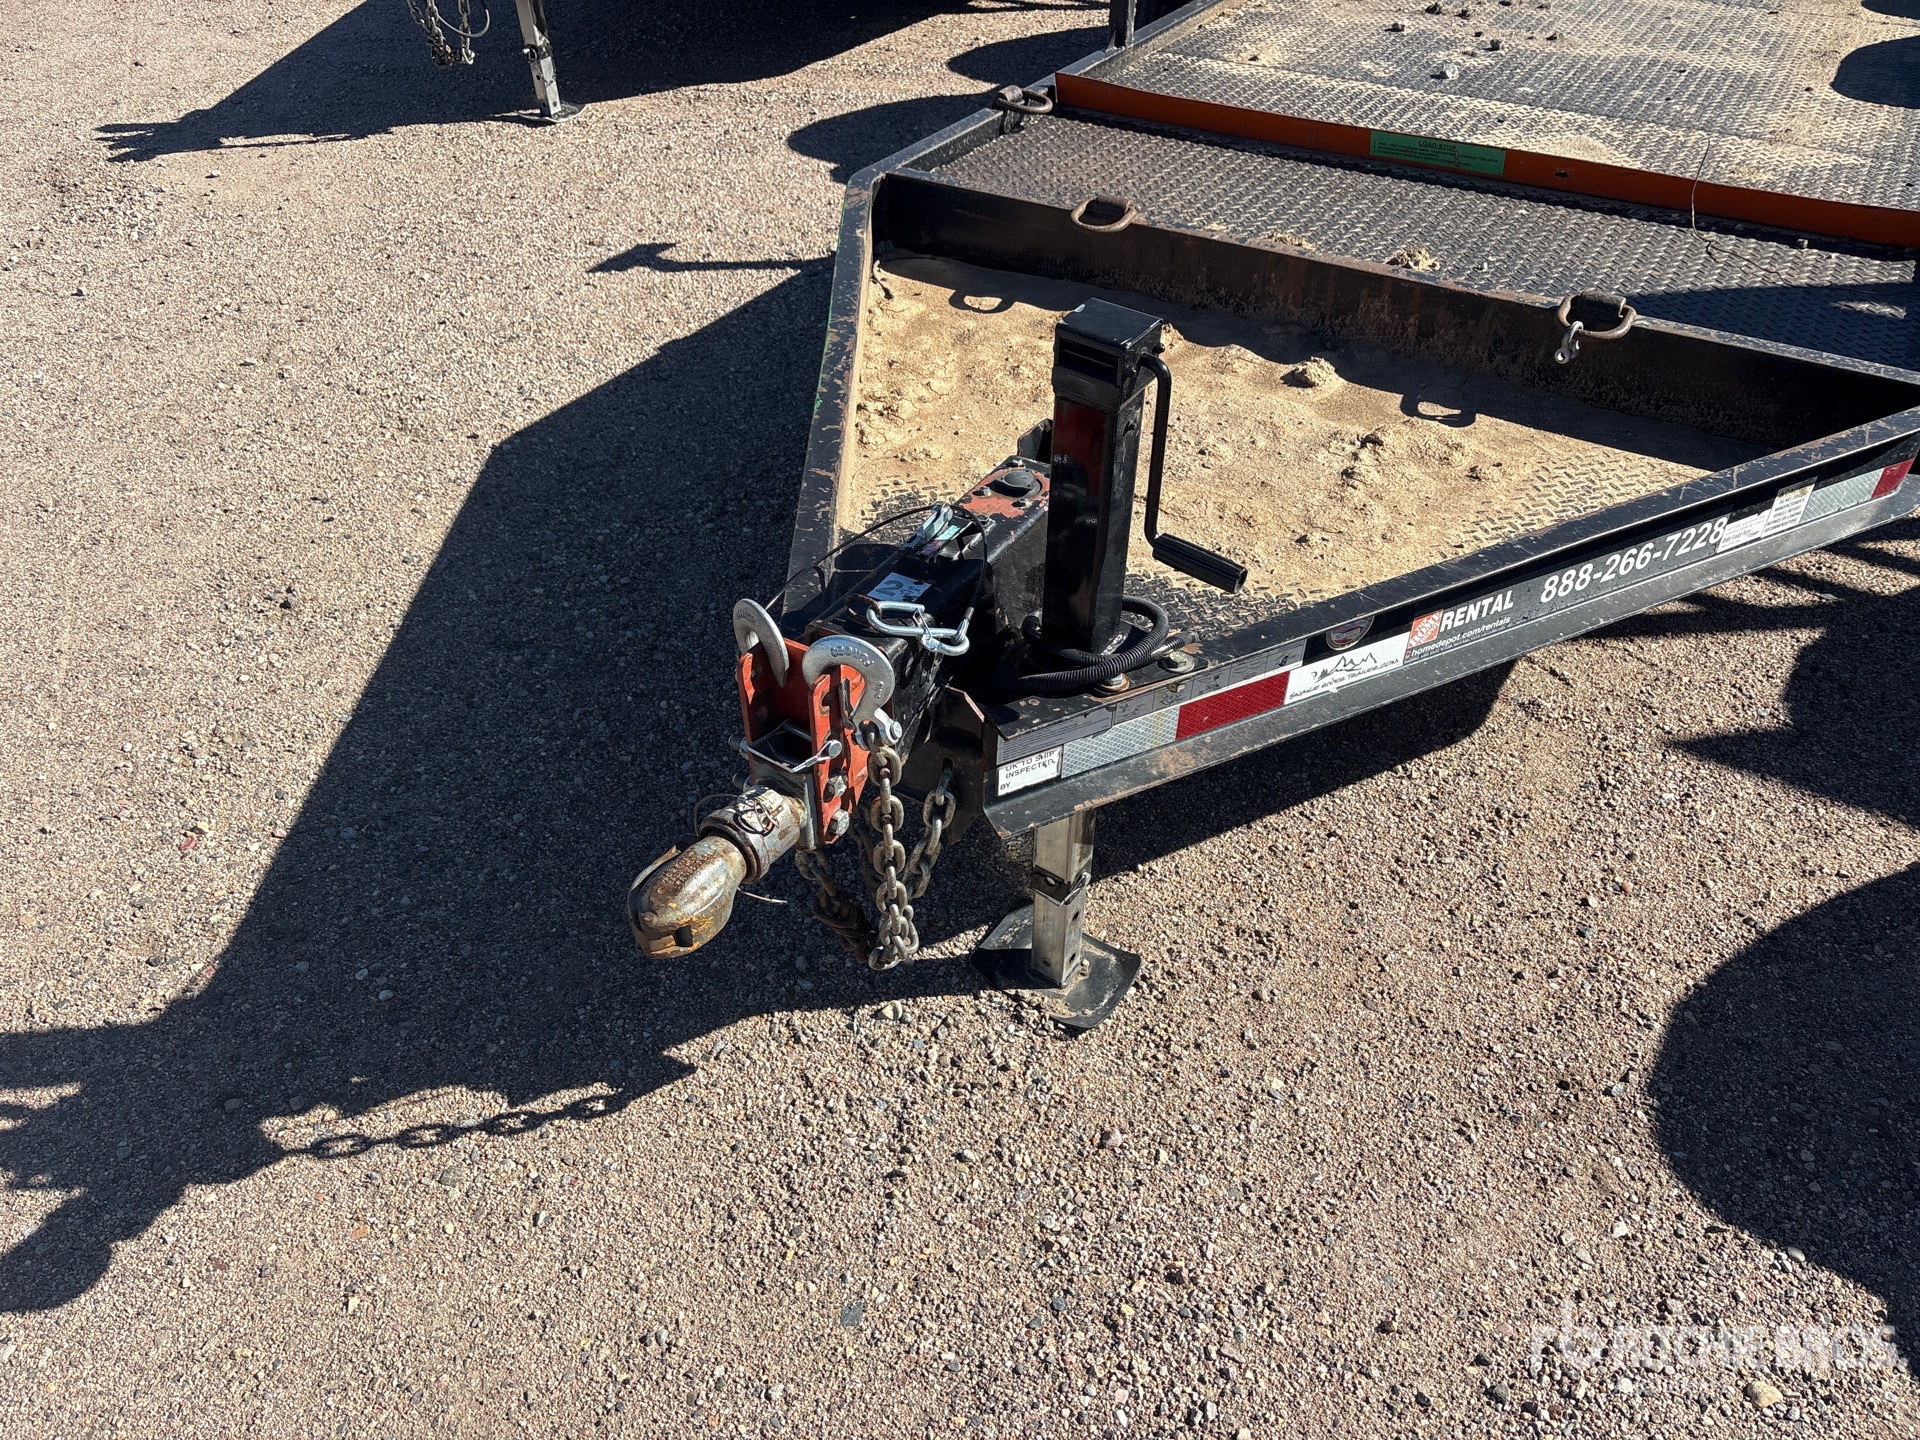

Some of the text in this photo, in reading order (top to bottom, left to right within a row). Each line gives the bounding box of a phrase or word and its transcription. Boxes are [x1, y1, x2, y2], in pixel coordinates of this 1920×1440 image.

[1419, 140, 1457, 151] LOAD STOP
[1540, 516, 1728, 603] 888-266-7228
[875, 580, 904, 597] 2
[1439, 590, 1514, 633] RENTAL
[1411, 616, 1511, 657] homedepot.com/rentals
[1021, 758, 1033, 767] TO
[1035, 750, 1055, 762] SHIP
[1000, 781, 1012, 791] BY
